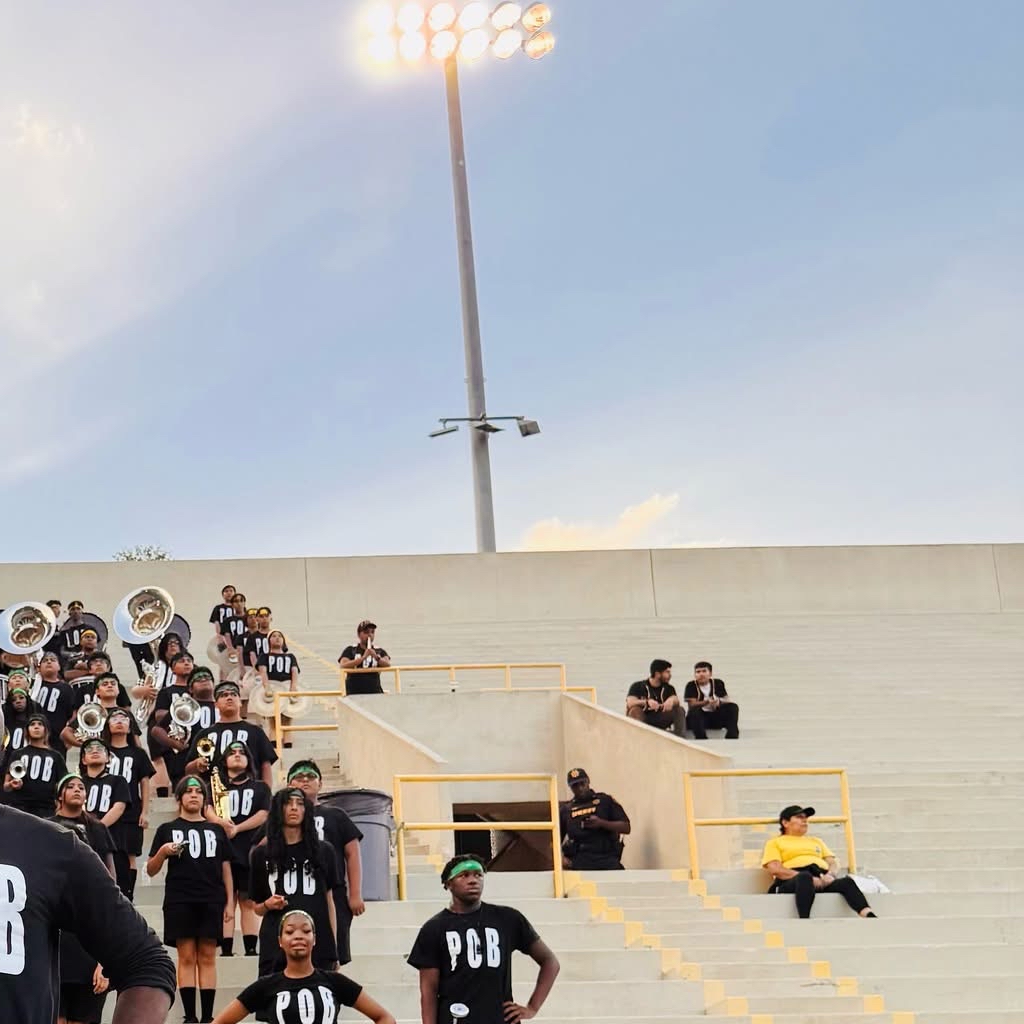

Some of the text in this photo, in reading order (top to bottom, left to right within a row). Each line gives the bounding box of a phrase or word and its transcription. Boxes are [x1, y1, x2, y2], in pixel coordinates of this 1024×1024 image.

[219, 607, 236, 624] PO
[230, 620, 248, 637] PO
[256, 637, 270, 656] PO
[87, 784, 112, 813] OB
[229, 788, 254, 817] OB
[445, 927, 502, 972] POB
